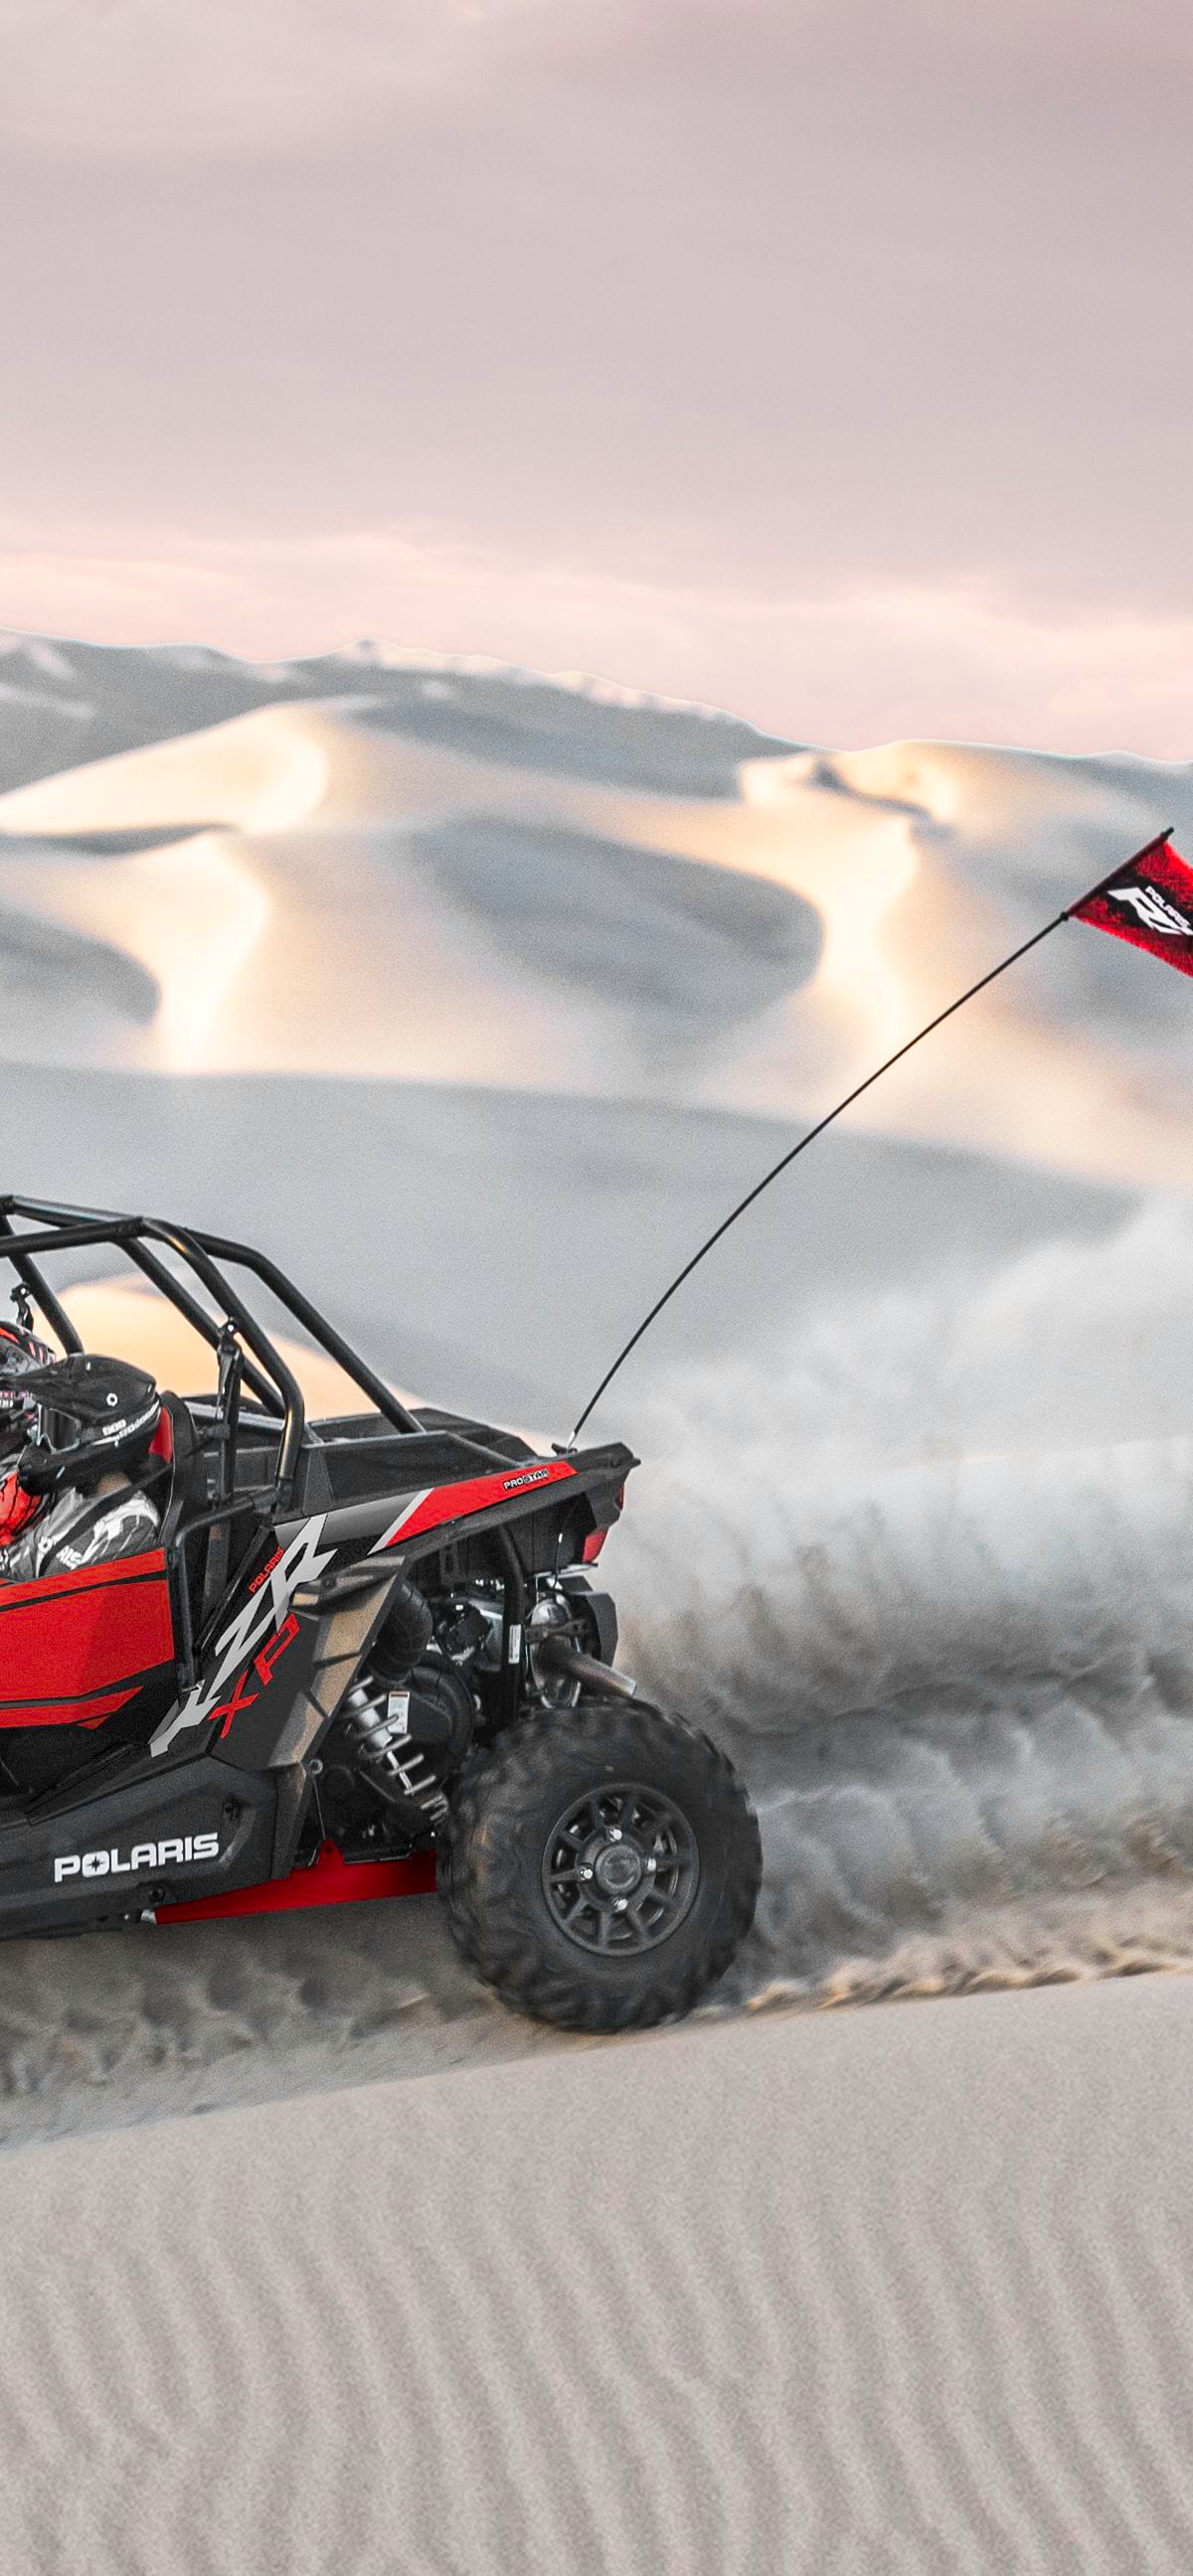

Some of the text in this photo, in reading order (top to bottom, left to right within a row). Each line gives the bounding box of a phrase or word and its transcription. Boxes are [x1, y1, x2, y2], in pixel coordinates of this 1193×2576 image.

[249, 1546, 284, 1593] POLARIS
[207, 1613, 301, 1739] XP
[54, 1833, 220, 1883] POLARIS
